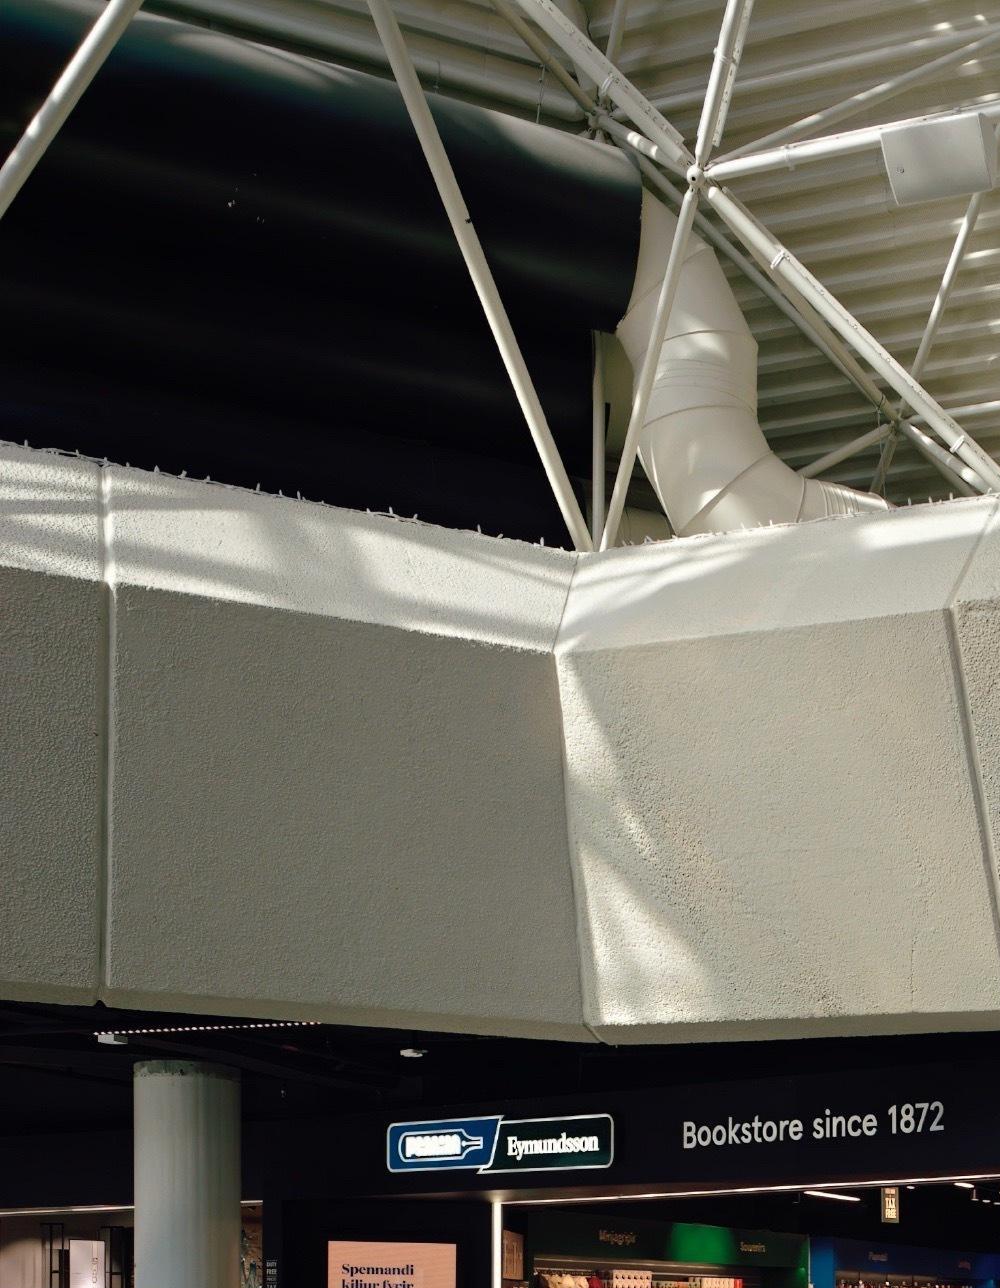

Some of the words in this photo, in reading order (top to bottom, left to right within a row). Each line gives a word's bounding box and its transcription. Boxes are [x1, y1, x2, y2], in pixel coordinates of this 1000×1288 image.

[683, 1115, 804, 1149] Bookstore
[812, 1108, 878, 1139] since
[888, 1101, 945, 1135] 1872
[507, 1132, 600, 1161] Eymundsson
[341, 1264, 414, 1277] Spennandi
